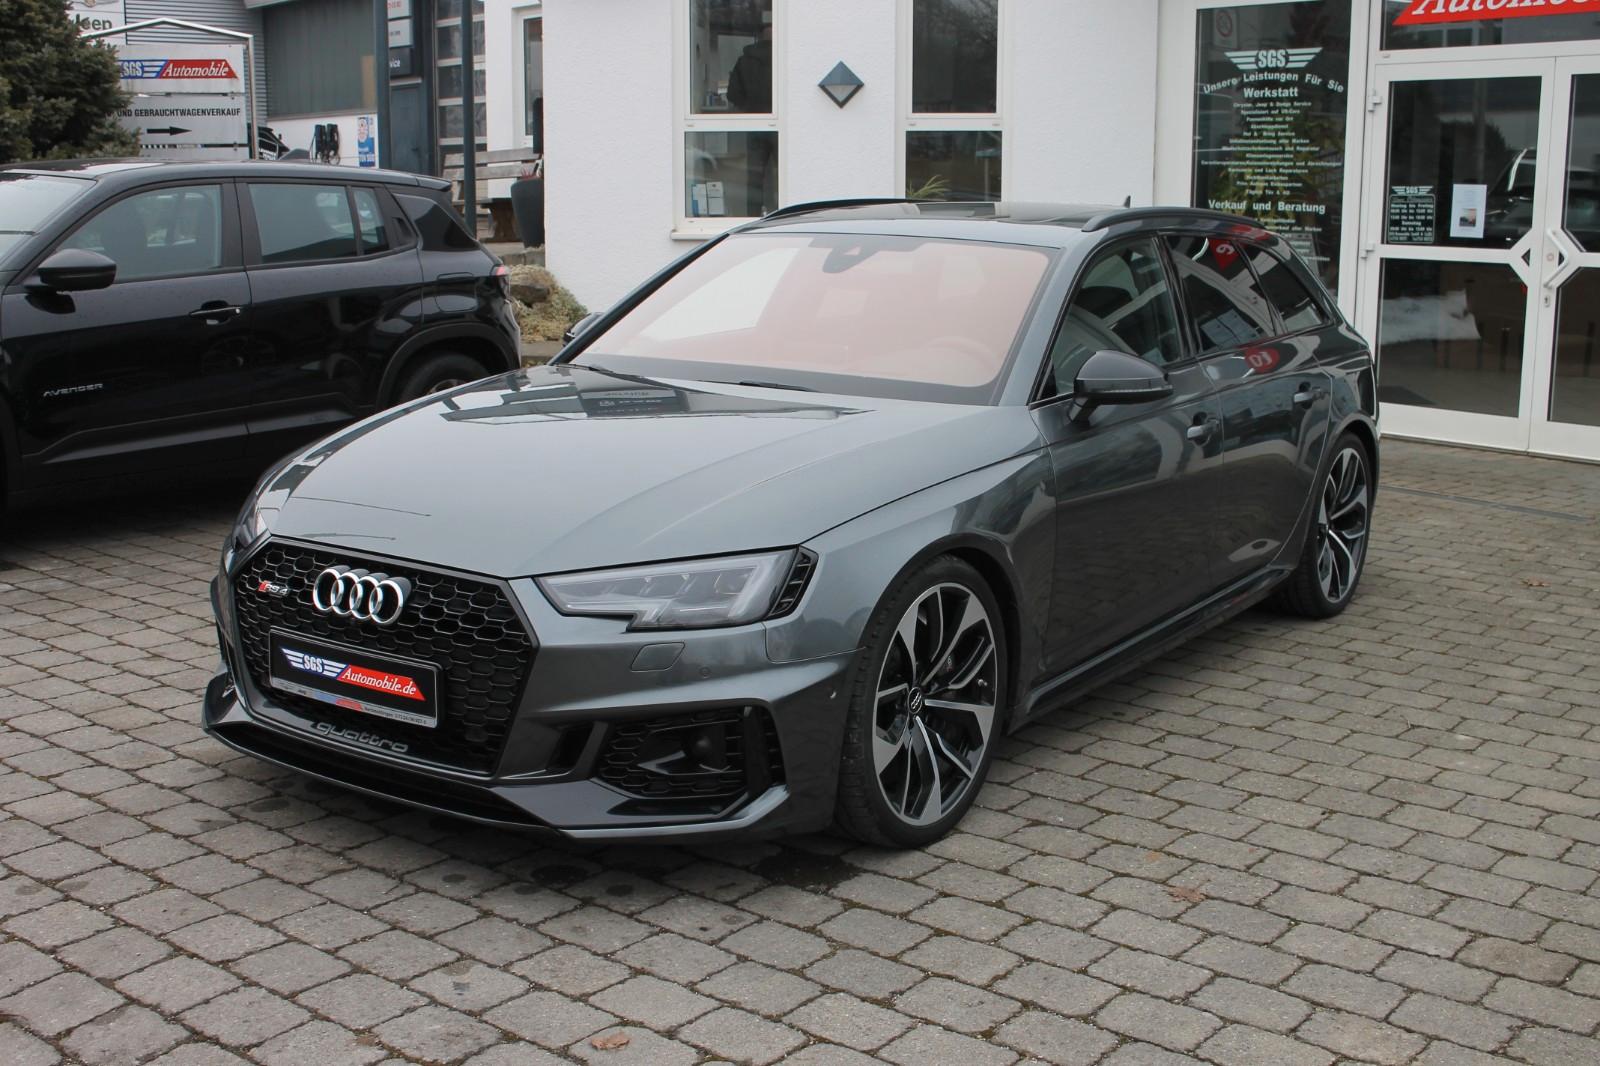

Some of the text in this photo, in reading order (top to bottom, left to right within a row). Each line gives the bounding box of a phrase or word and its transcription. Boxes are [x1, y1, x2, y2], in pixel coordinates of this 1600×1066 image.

[1257, 49, 1287, 68] SGS
[123, 61, 229, 77] SGS Automobile
[1203, 71, 1344, 94] Unsere Leistungen Für Sie
[1243, 87, 1299, 98] Werkstatt
[134, 107, 241, 118] GEBRAUCHTWAGENVERKAUF
[1208, 200, 1326, 215] Verkauf und Beratung
[43, 383, 103, 397] AVENGER
[302, 653, 417, 696] SGS Automobile.de
[316, 721, 409, 753] quattro
